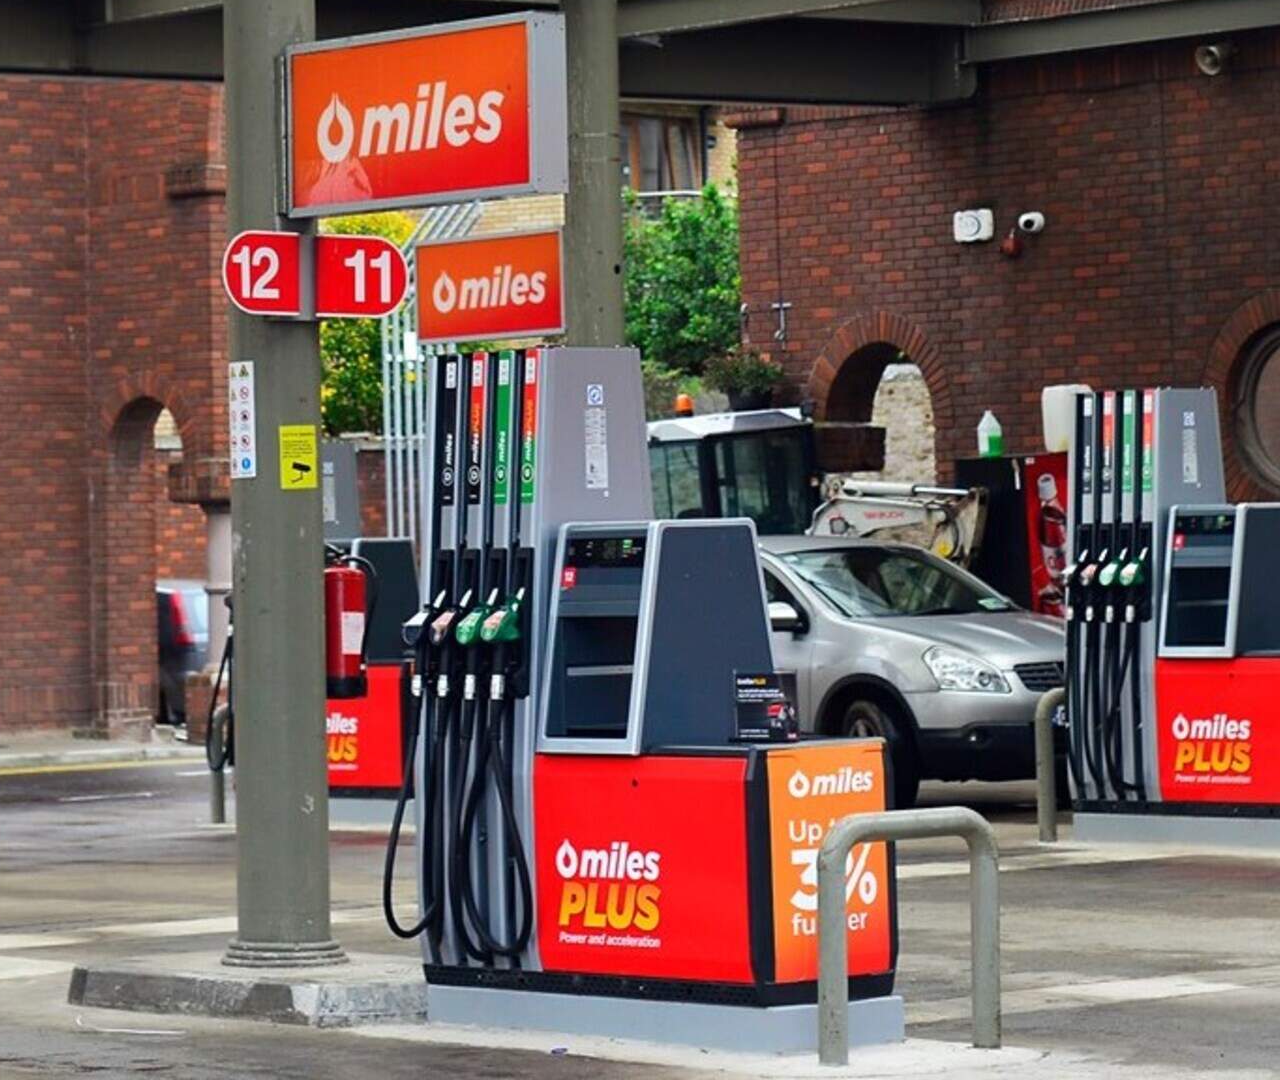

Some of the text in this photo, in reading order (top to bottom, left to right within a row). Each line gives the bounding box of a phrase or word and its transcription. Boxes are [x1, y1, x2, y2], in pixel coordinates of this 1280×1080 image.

[358, 80, 505, 158] miles
[231, 245, 280, 300] 12
[344, 249, 391, 304] 11
[458, 265, 548, 311] miles
[1190, 713, 1252, 740] miles
[328, 734, 358, 762] US
[1175, 740, 1252, 773] PLUS
[811, 766, 873, 797] miles
[789, 819, 823, 846] Up
[579, 841, 661, 881] miles
[558, 880, 662, 932] PLUS
[559, 930, 662, 948] Power and acceleration
[791, 912, 869, 937] fuer
